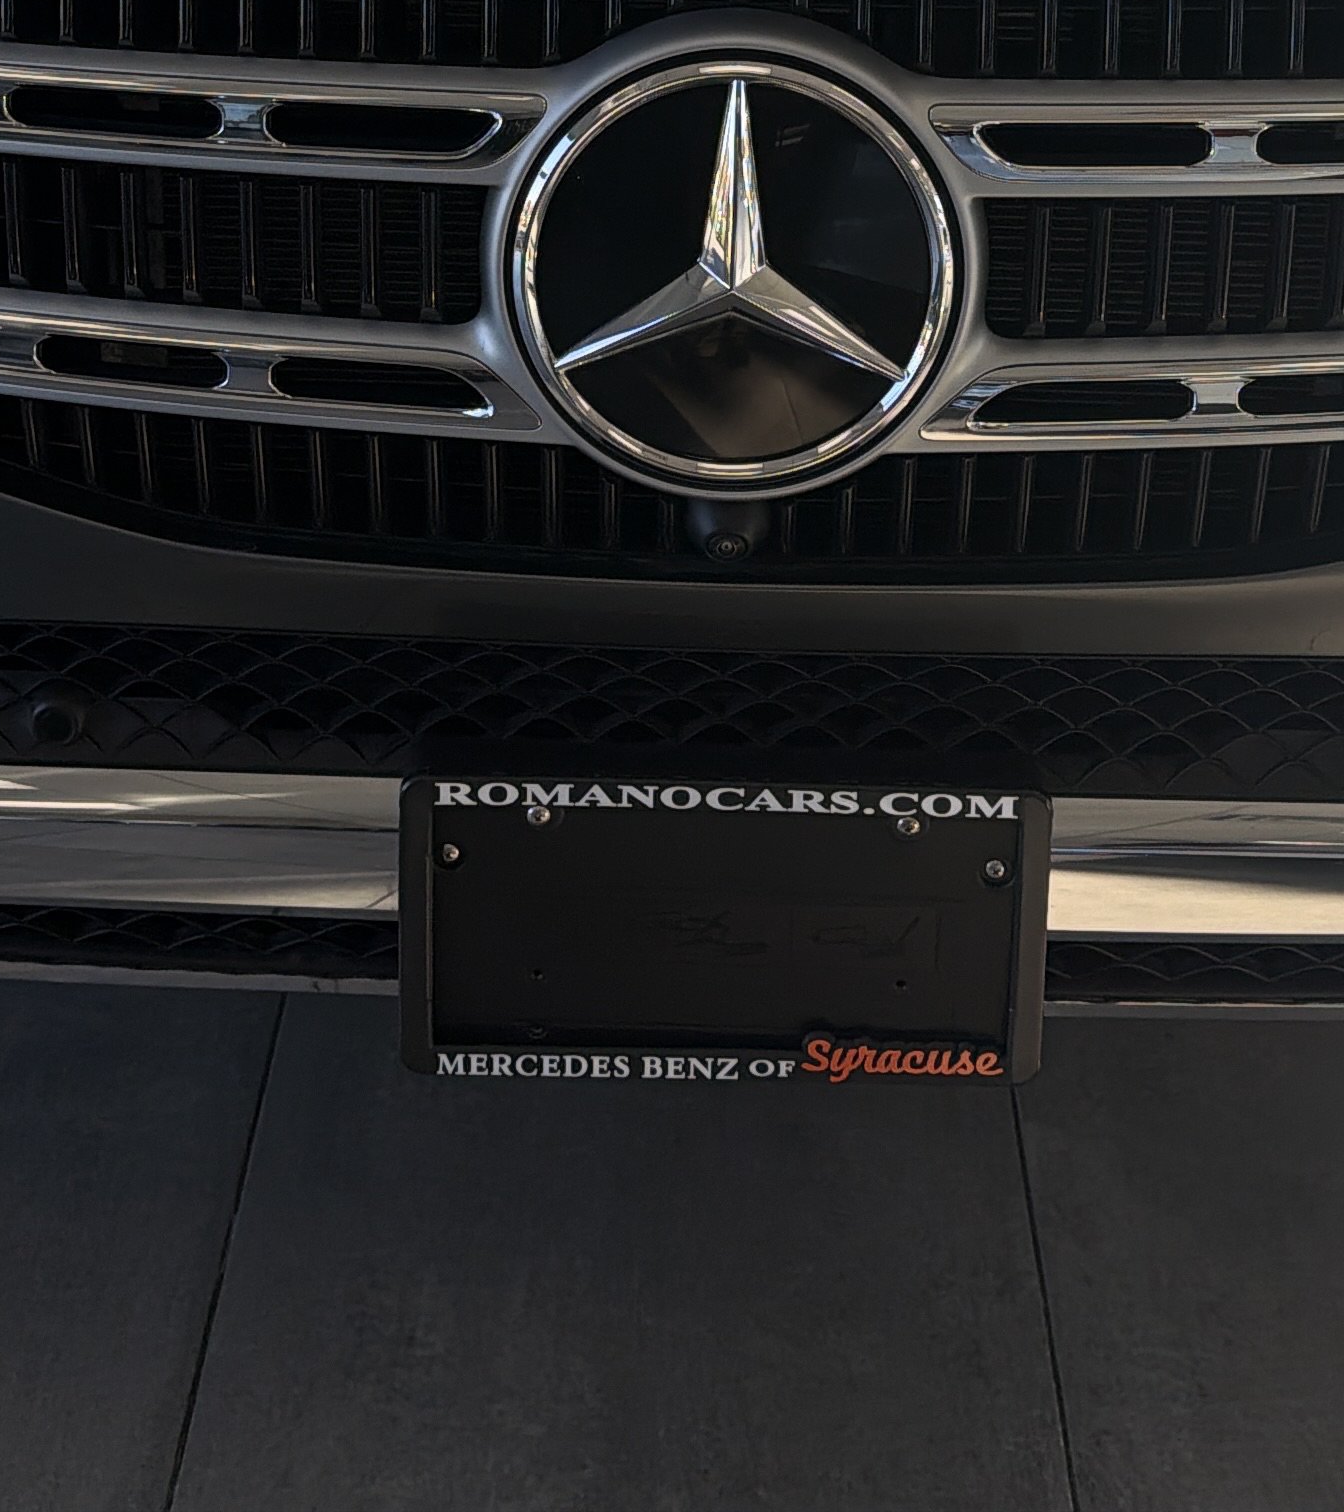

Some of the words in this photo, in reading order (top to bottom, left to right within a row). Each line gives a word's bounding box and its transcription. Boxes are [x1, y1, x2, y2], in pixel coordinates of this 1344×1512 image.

[434, 782, 1019, 819] ROMANOCARS.COM
[436, 1052, 631, 1079] MERCEDES
[641, 1055, 739, 1081] BENZ
[749, 1058, 796, 1079] OF
[802, 1039, 1003, 1082] Syracuse
